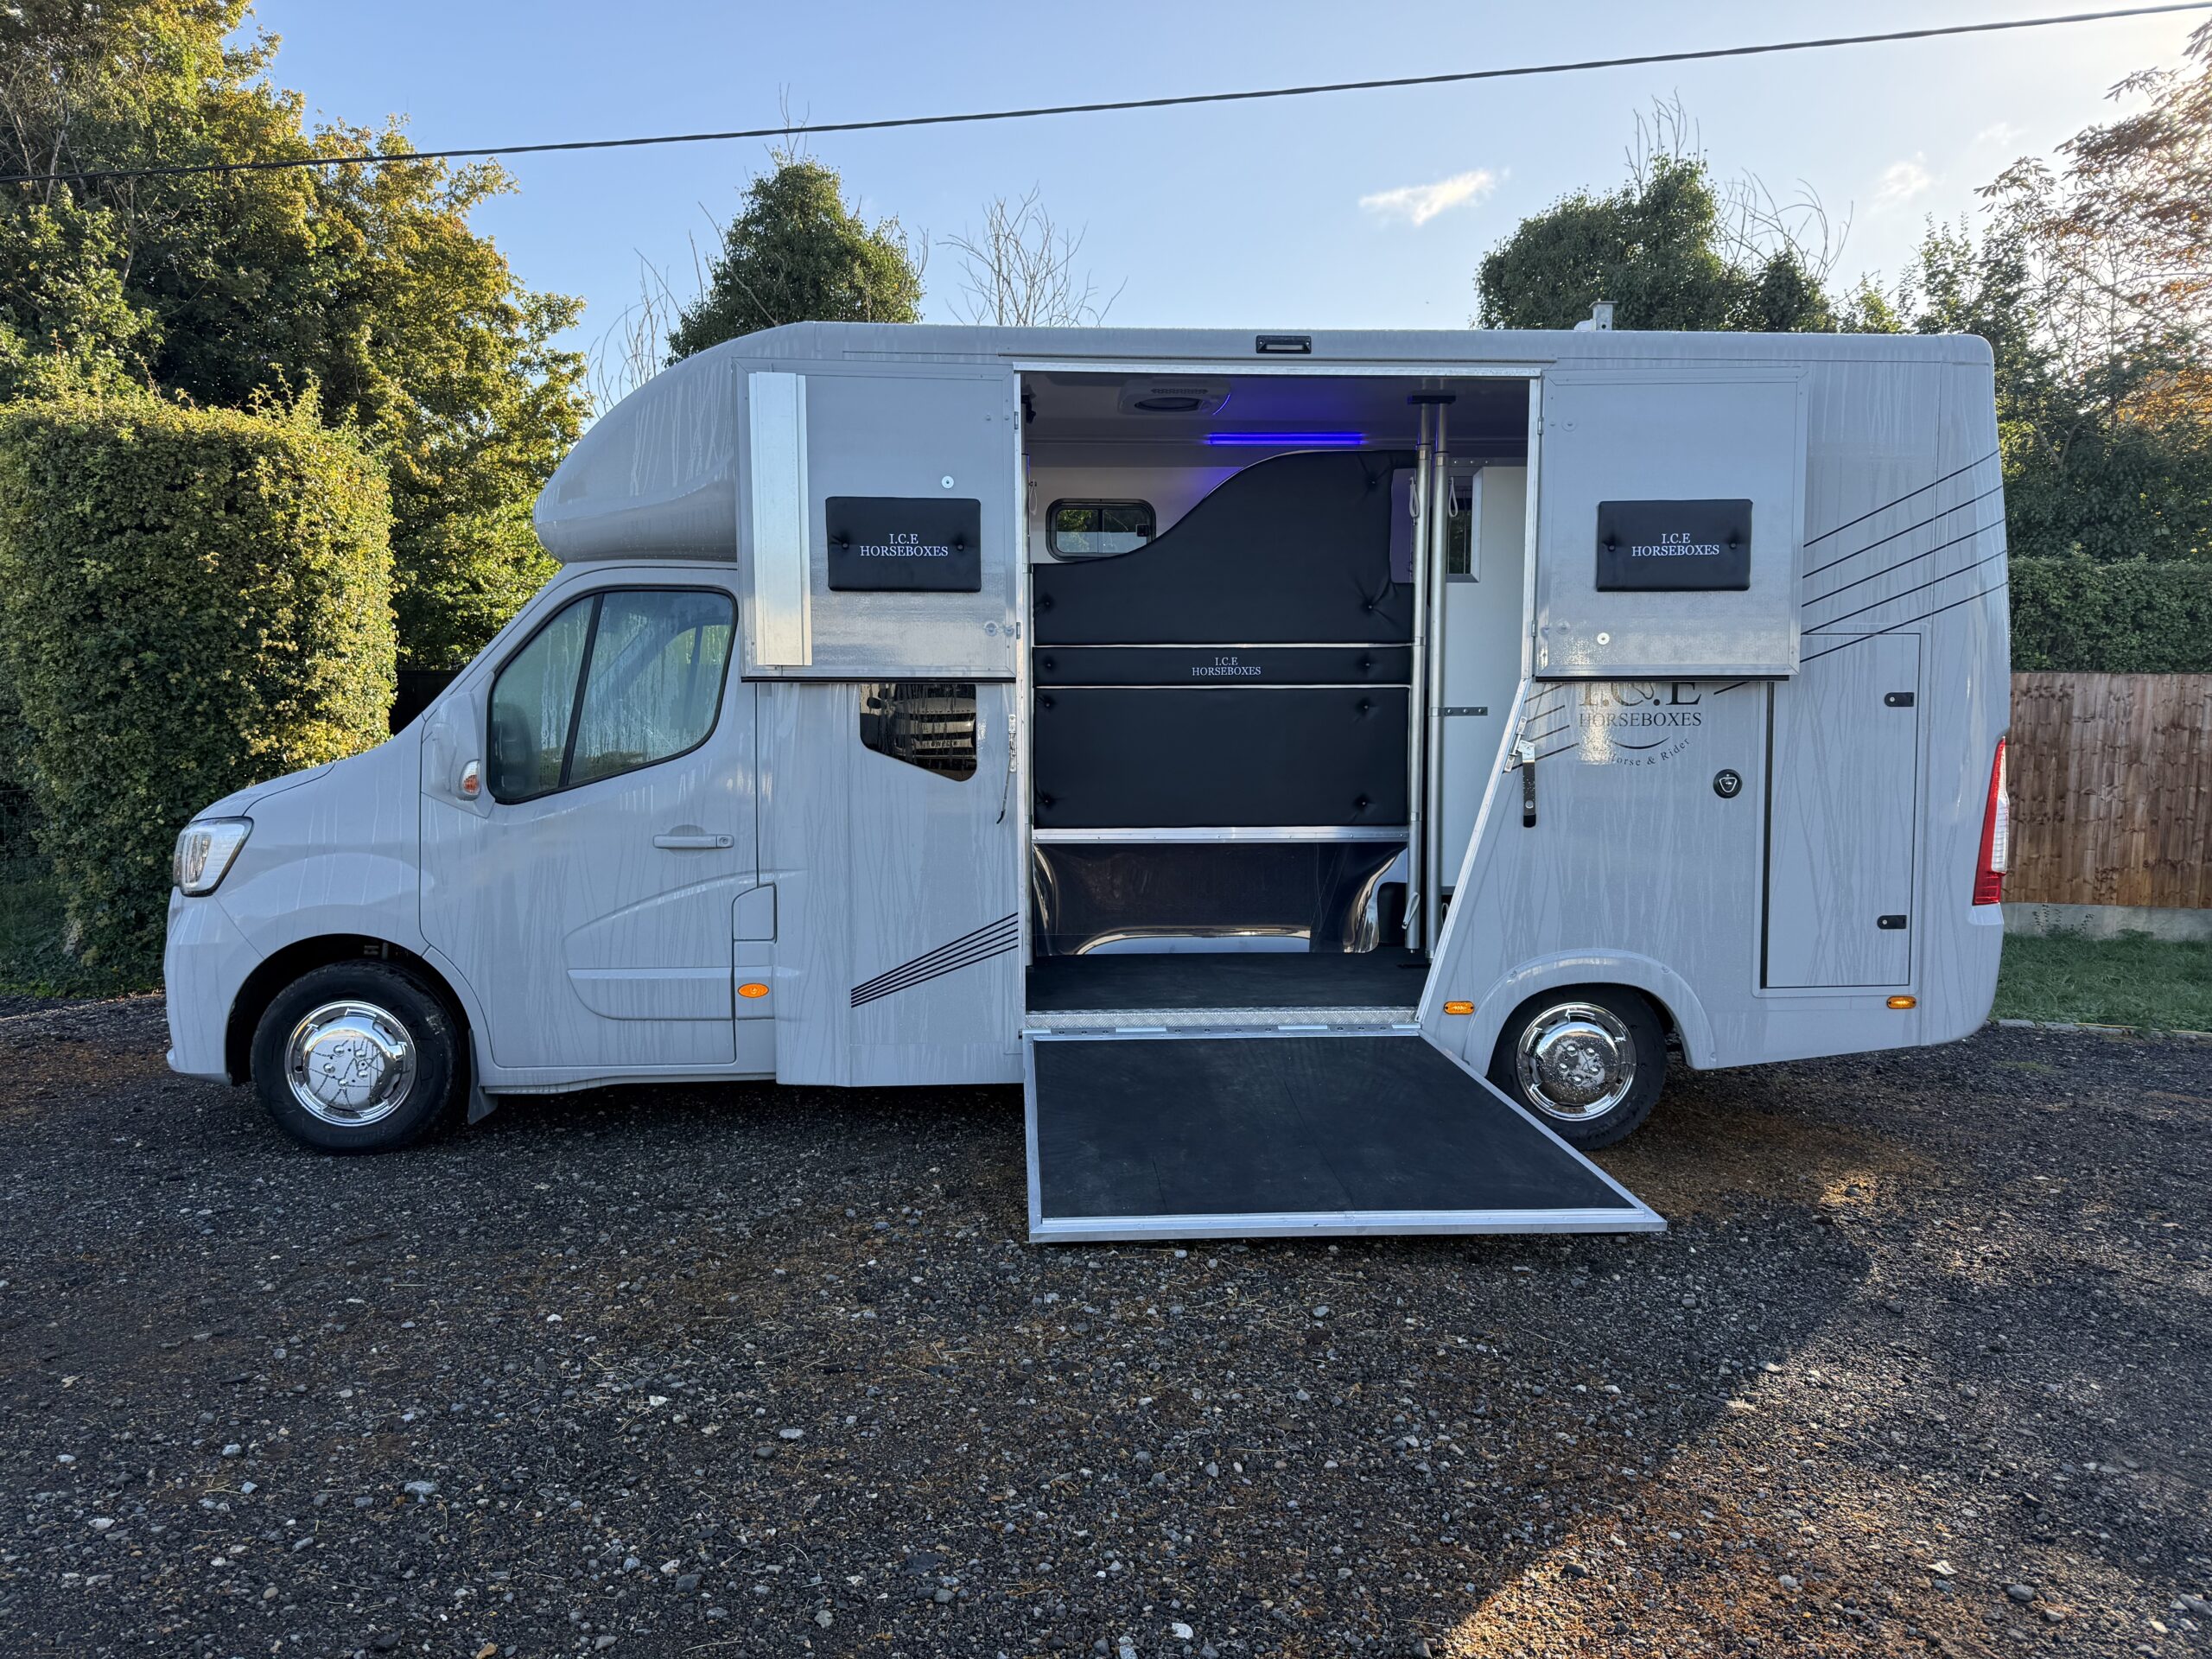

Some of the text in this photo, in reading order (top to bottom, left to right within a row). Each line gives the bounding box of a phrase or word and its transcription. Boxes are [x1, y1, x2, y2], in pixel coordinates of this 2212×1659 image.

[889, 533, 918, 544] I.C.E
[1662, 532, 1691, 544] I.C.E
[860, 545, 949, 556] HORSEBOXES
[1631, 544, 1719, 556] HORSEBOXES
[1215, 657, 1238, 666] I.C.E
[1192, 666, 1262, 676] HORSEBOXES
[1579, 712, 1702, 727] HORSEBOXES
[1647, 755, 1656, 766] &
[1660, 737, 1690, 761] Rider
